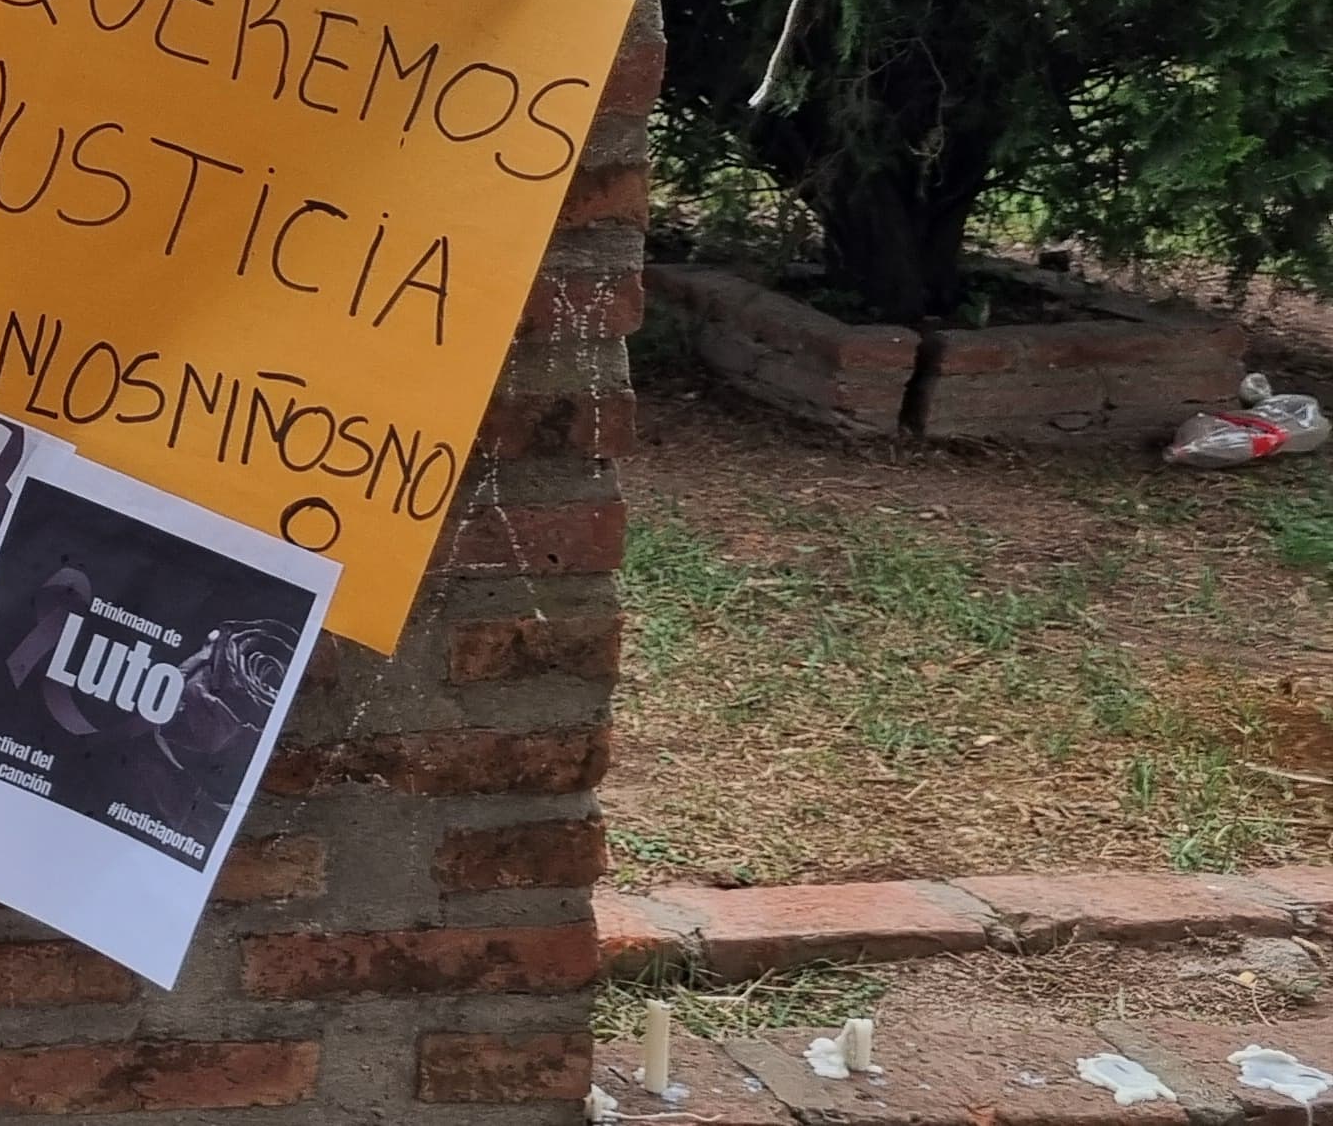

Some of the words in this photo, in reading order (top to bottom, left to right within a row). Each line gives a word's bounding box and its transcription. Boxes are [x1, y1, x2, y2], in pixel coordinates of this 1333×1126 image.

[89, 597, 163, 641] Brinkmann
[163, 627, 183, 649] de
[45, 612, 185, 725] Luto
[31, 747, 56, 772] del
[106, 801, 206, 861] #justiciaporAra
